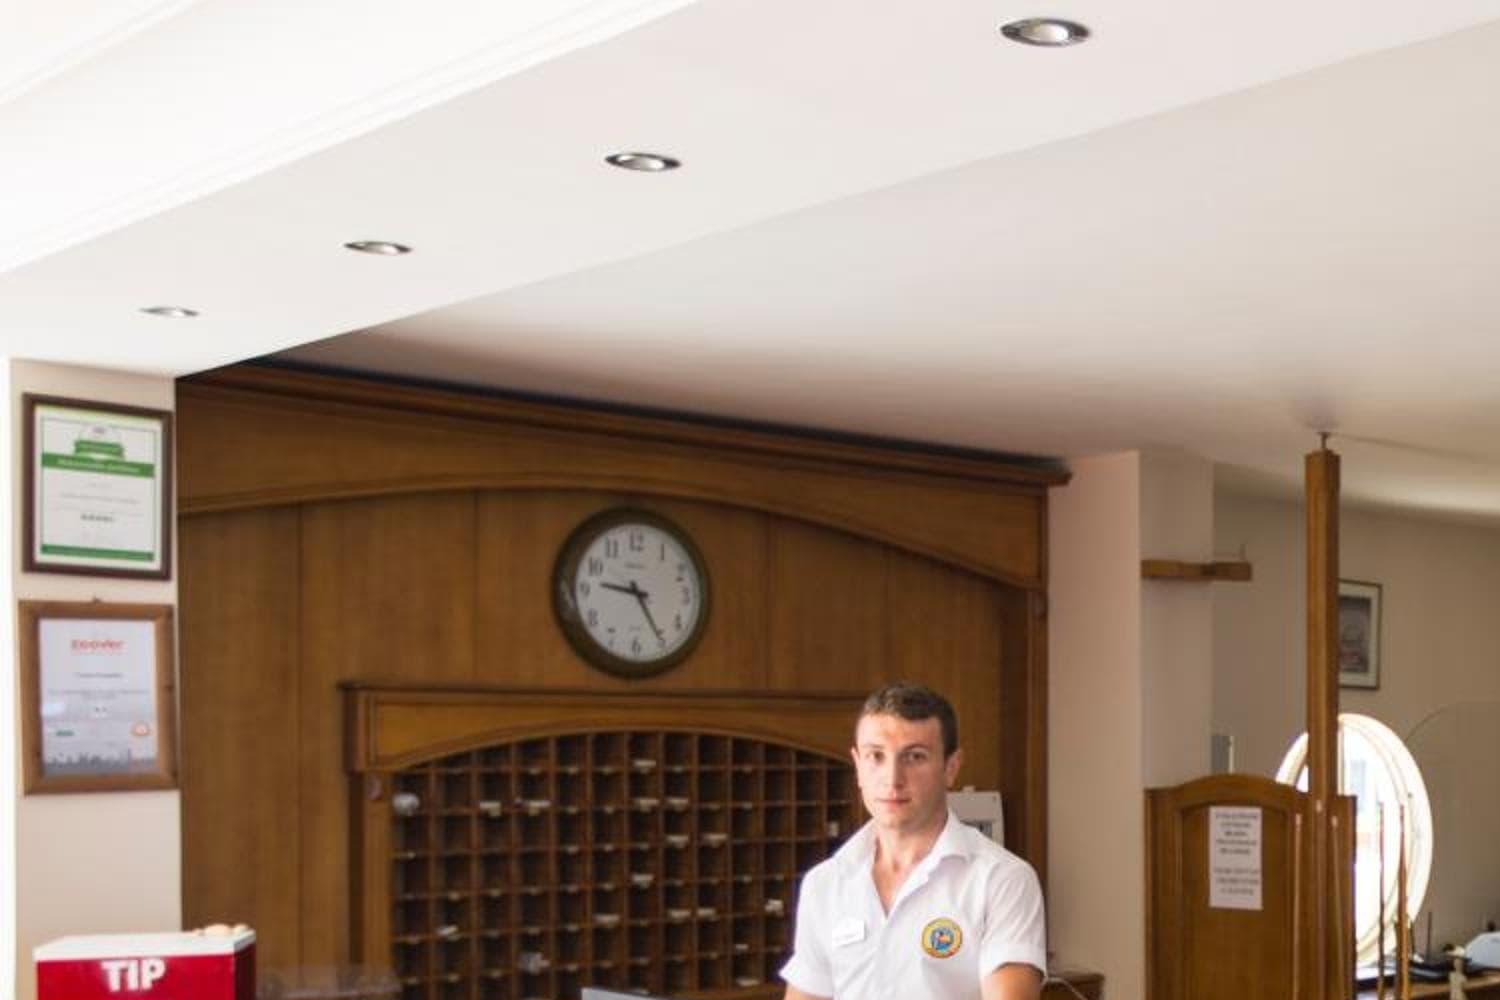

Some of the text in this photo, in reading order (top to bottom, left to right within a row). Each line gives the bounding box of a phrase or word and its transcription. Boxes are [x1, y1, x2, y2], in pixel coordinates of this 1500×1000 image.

[606, 539, 619, 558] 11
[630, 530, 643, 551] 12
[588, 557, 603, 576] 10
[632, 637, 641, 655] 6
[100, 958, 166, 992] TIP
